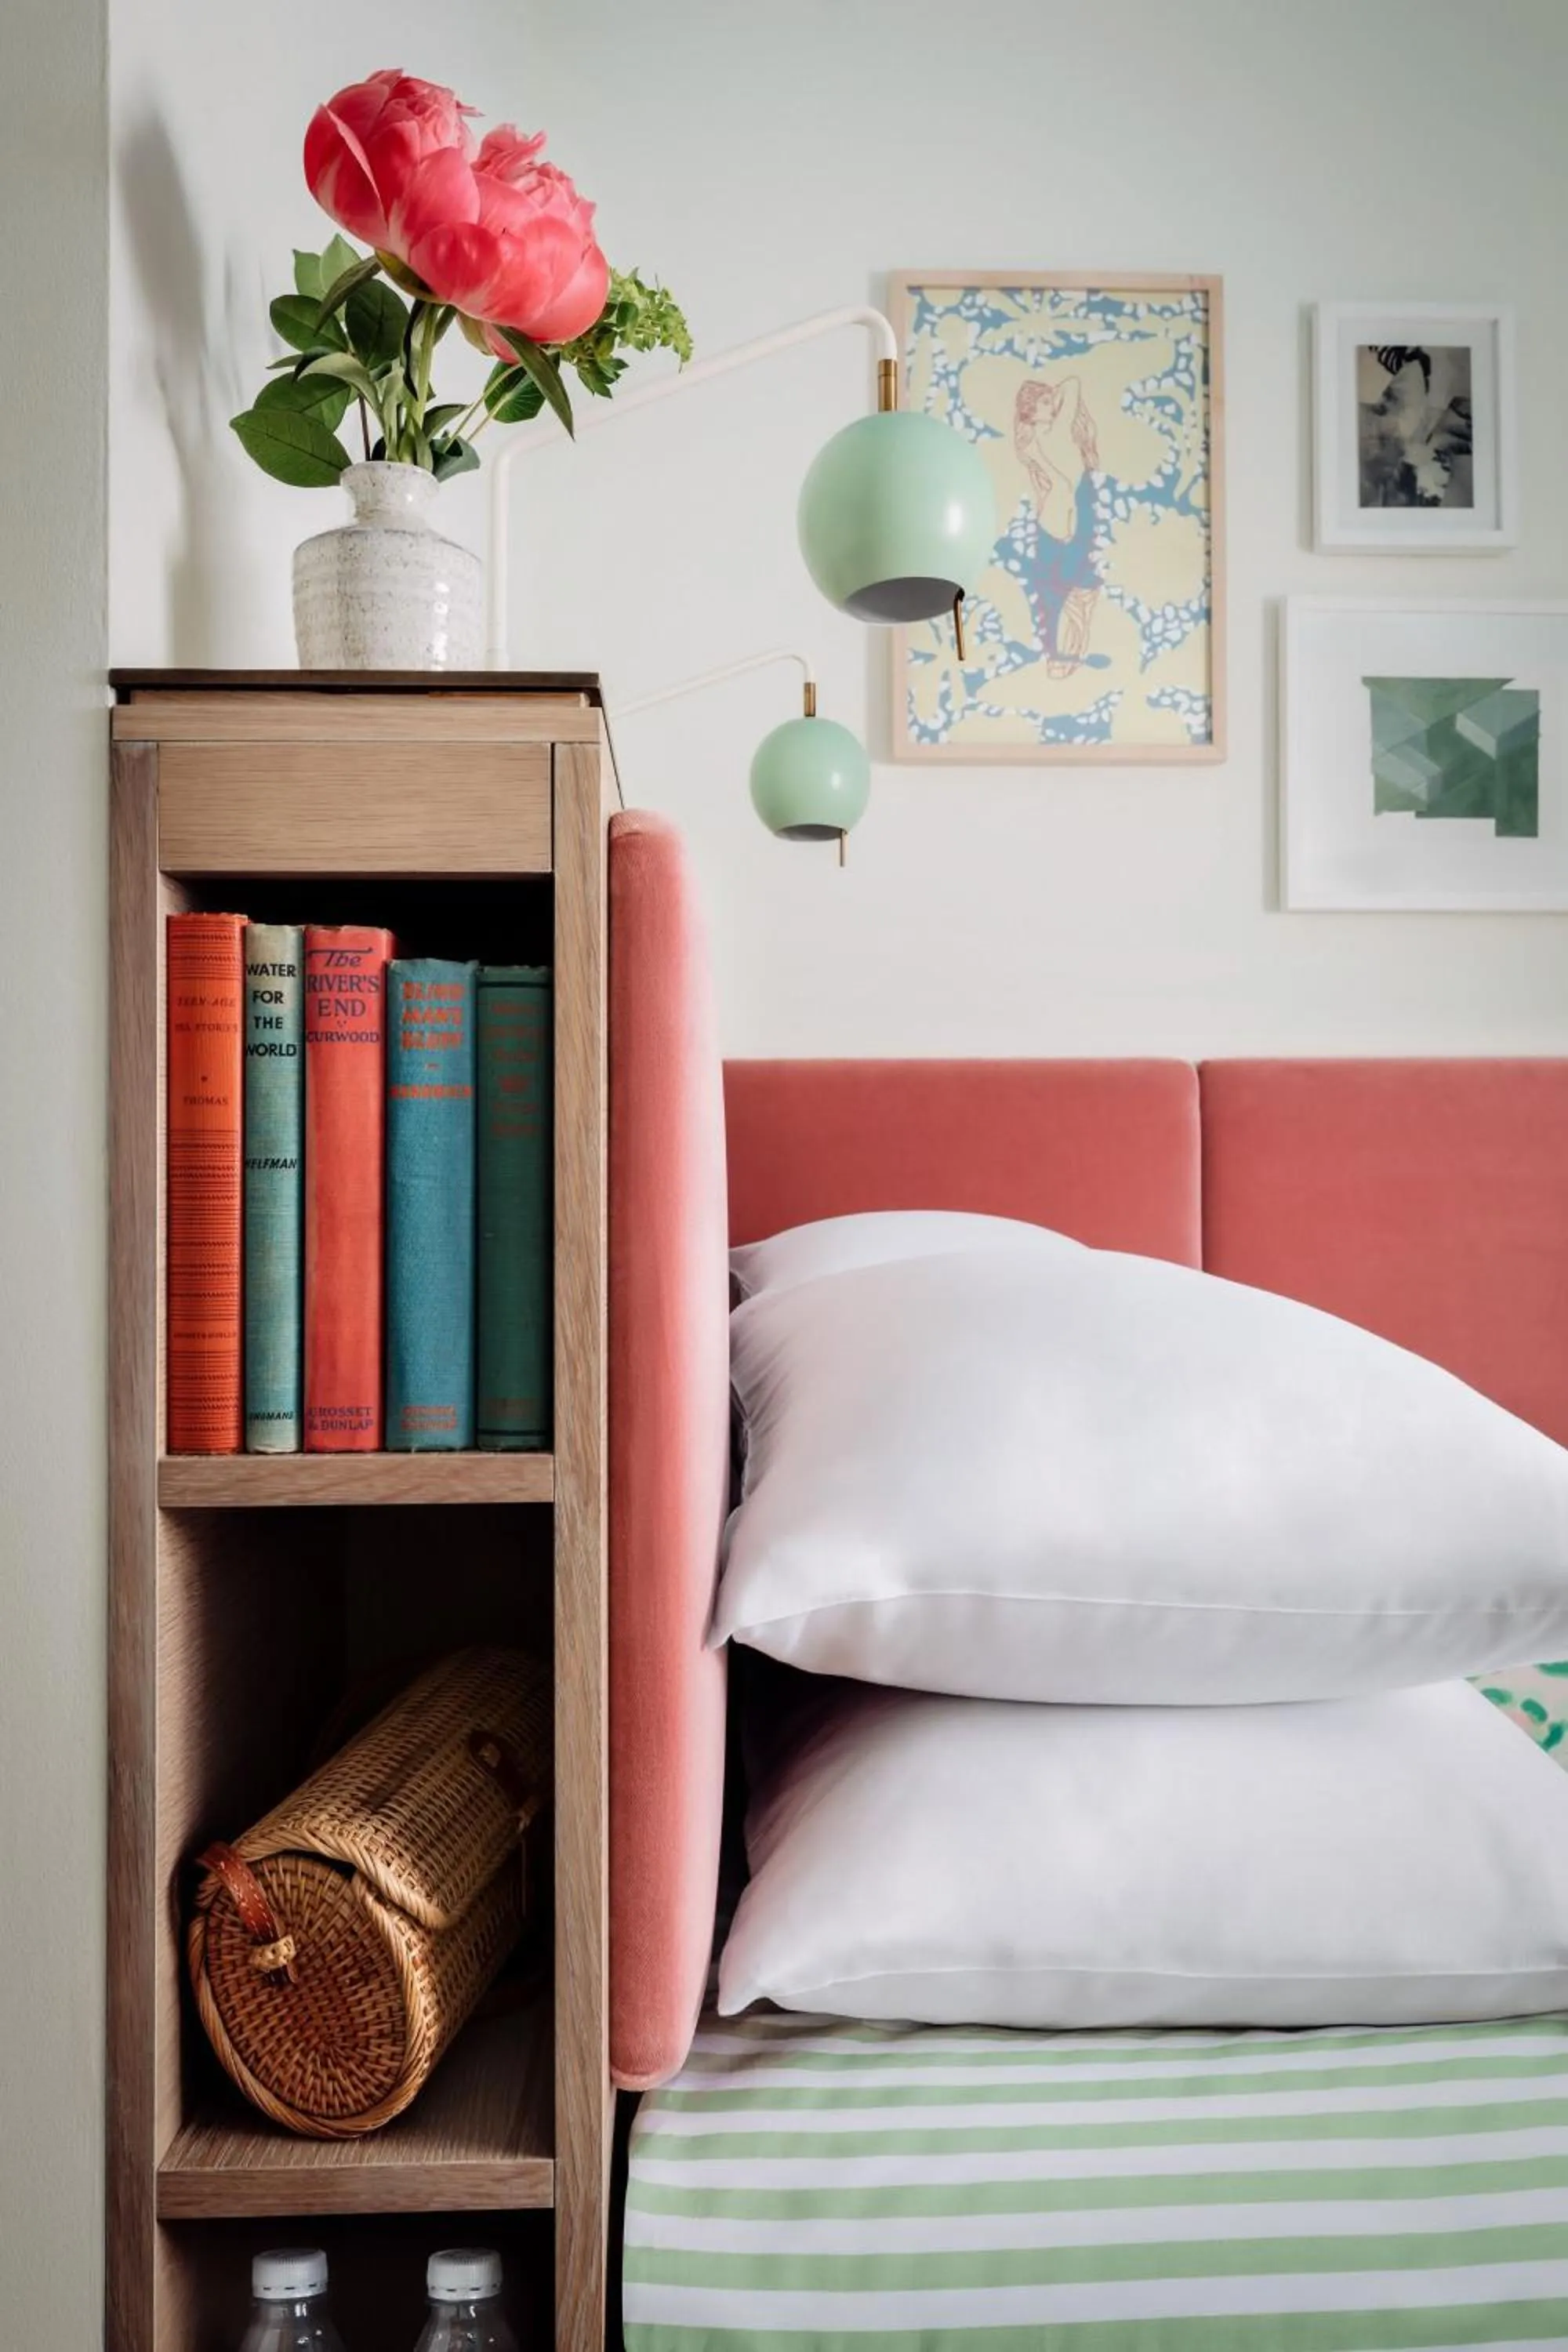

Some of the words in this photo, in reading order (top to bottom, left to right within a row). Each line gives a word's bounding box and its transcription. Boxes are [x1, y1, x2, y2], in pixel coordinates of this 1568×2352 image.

[245, 963, 296, 978] WATER
[306, 975, 380, 993] RIVER'S
[252, 990, 285, 1004] FOR
[318, 998, 366, 1018] END
[253, 1015, 284, 1029] THE
[306, 1031, 379, 1044] CURWOOD
[245, 1043, 297, 1057] WORLD
